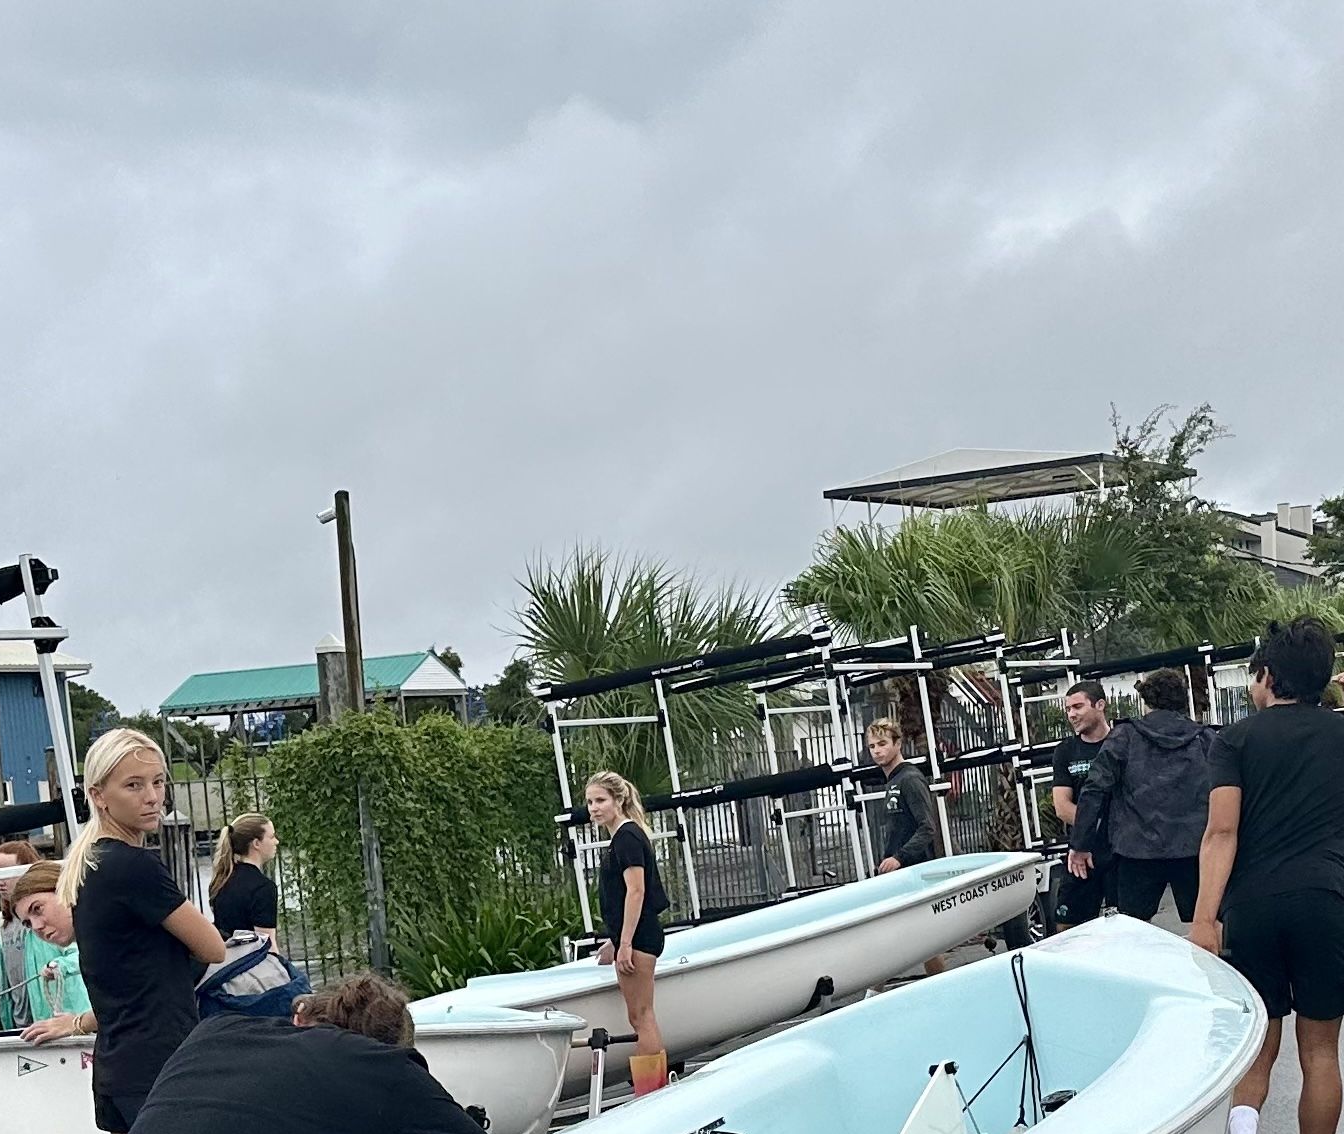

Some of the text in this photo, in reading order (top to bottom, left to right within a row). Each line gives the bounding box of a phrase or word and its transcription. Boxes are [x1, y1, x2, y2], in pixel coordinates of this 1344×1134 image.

[931, 869, 1025, 915] WEST COAST SAILING
